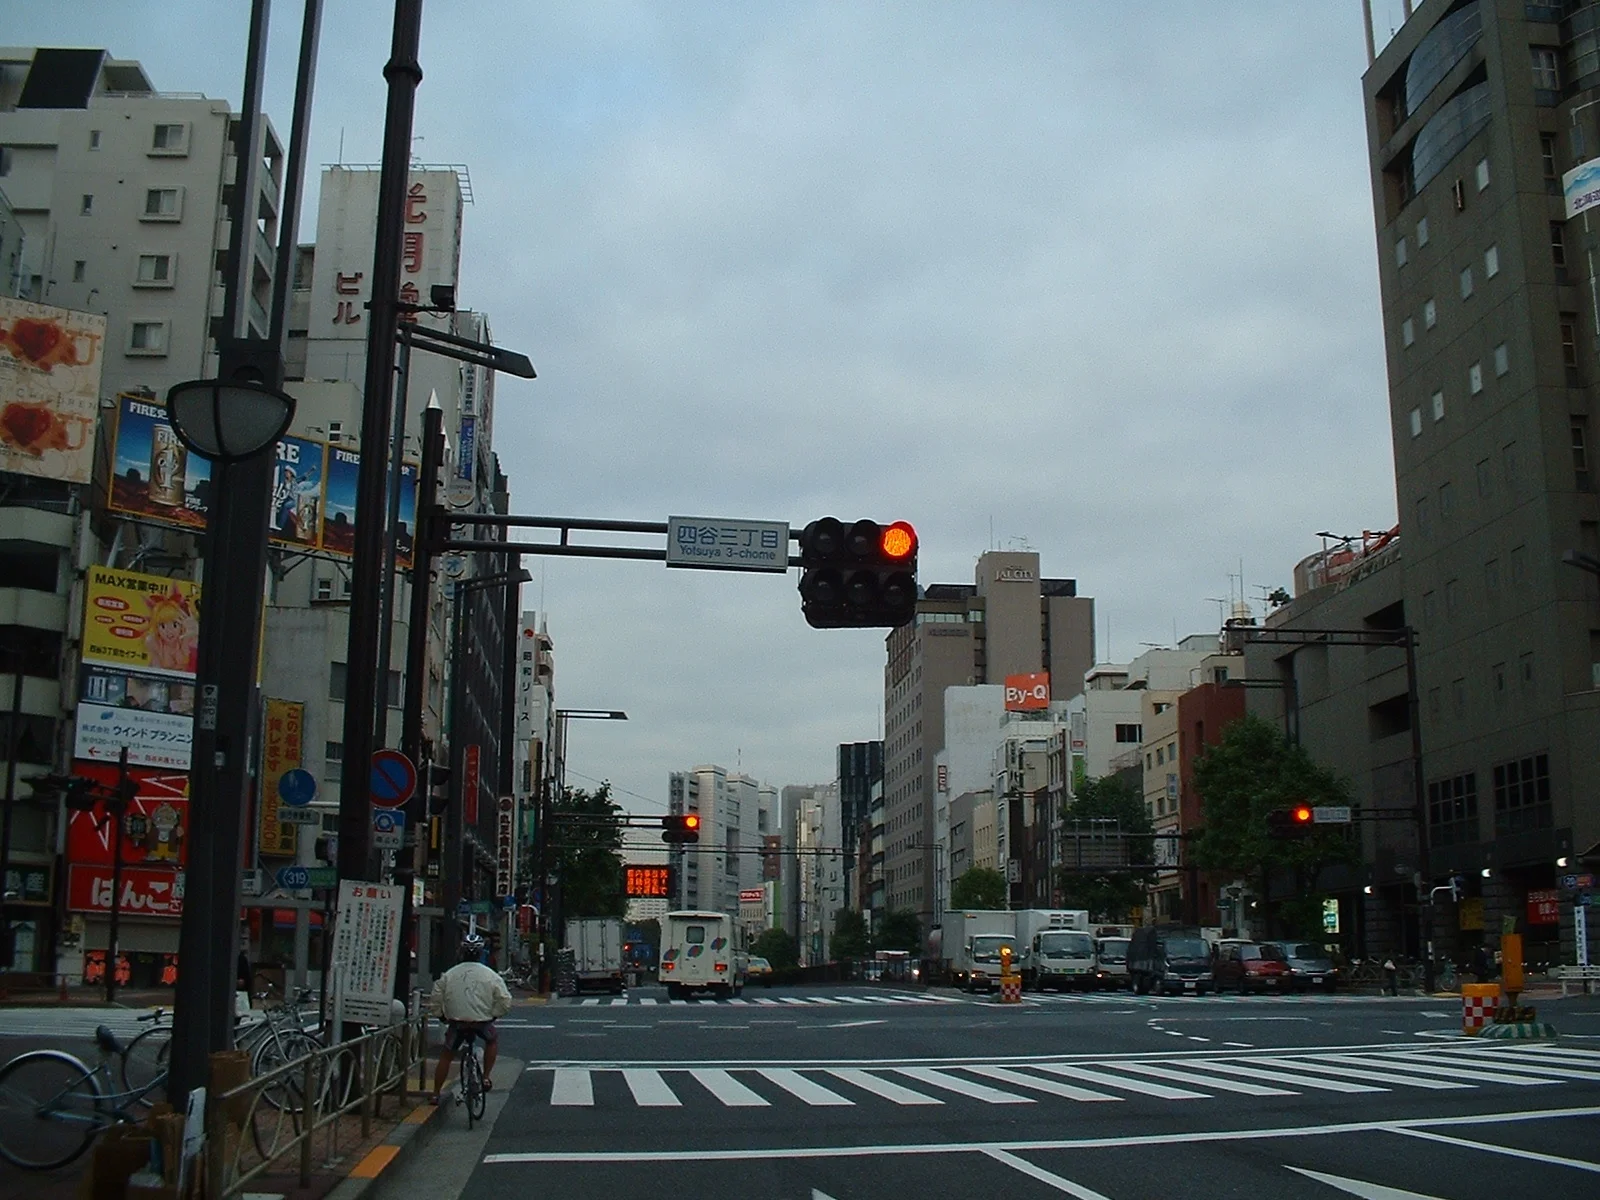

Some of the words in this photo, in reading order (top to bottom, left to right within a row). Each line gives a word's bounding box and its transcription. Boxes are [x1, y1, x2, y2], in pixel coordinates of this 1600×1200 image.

[332, 272, 362, 325] ビル
[677, 525, 778, 548] 四谷三丁目
[680, 545, 721, 558] Yotsuya
[726, 547, 776, 560] 3-chome
[521, 650, 533, 722] 昭和リース
[1006, 684, 1048, 703] By-Q
[287, 871, 307, 885] 319
[91, 877, 169, 912] はんこ
